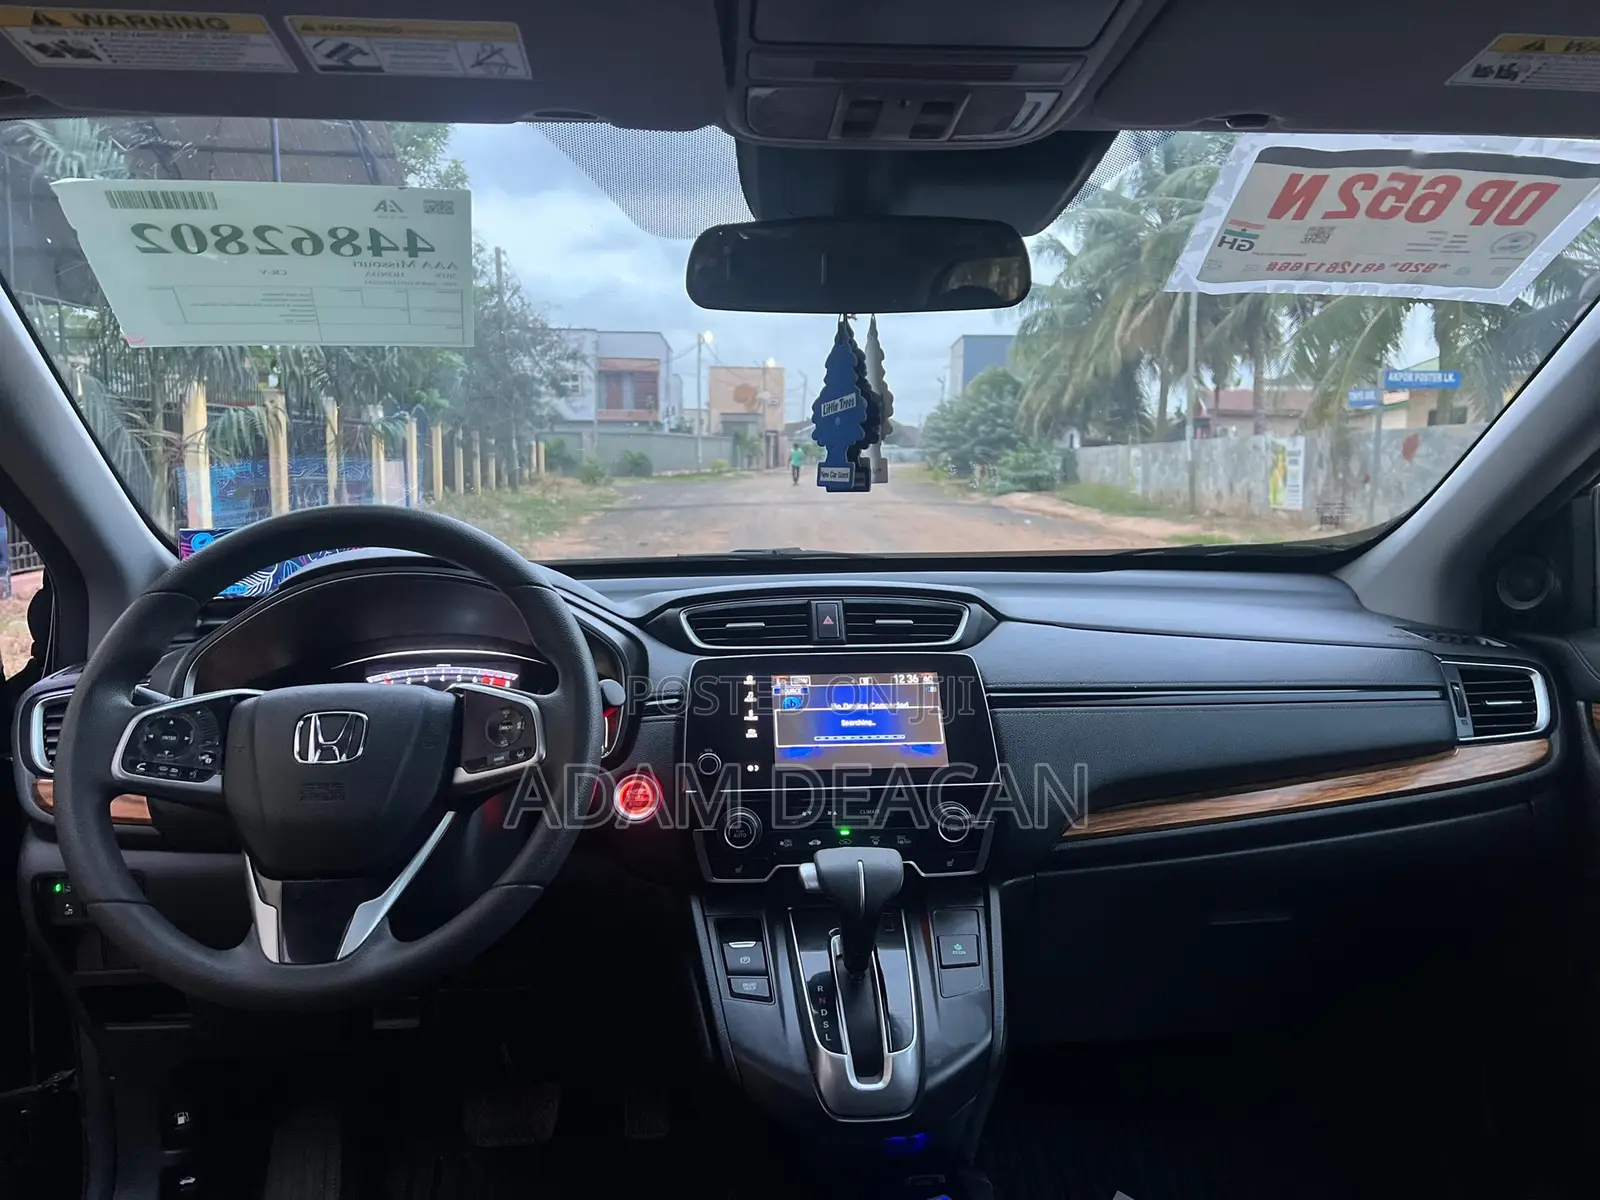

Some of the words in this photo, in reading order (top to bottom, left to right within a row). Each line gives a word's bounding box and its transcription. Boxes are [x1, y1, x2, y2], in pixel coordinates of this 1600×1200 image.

[72, 12, 230, 31] WARNING
[822, 401, 839, 416] Little
[839, 396, 855, 411] Trees
[820, 1008, 828, 1016] D
